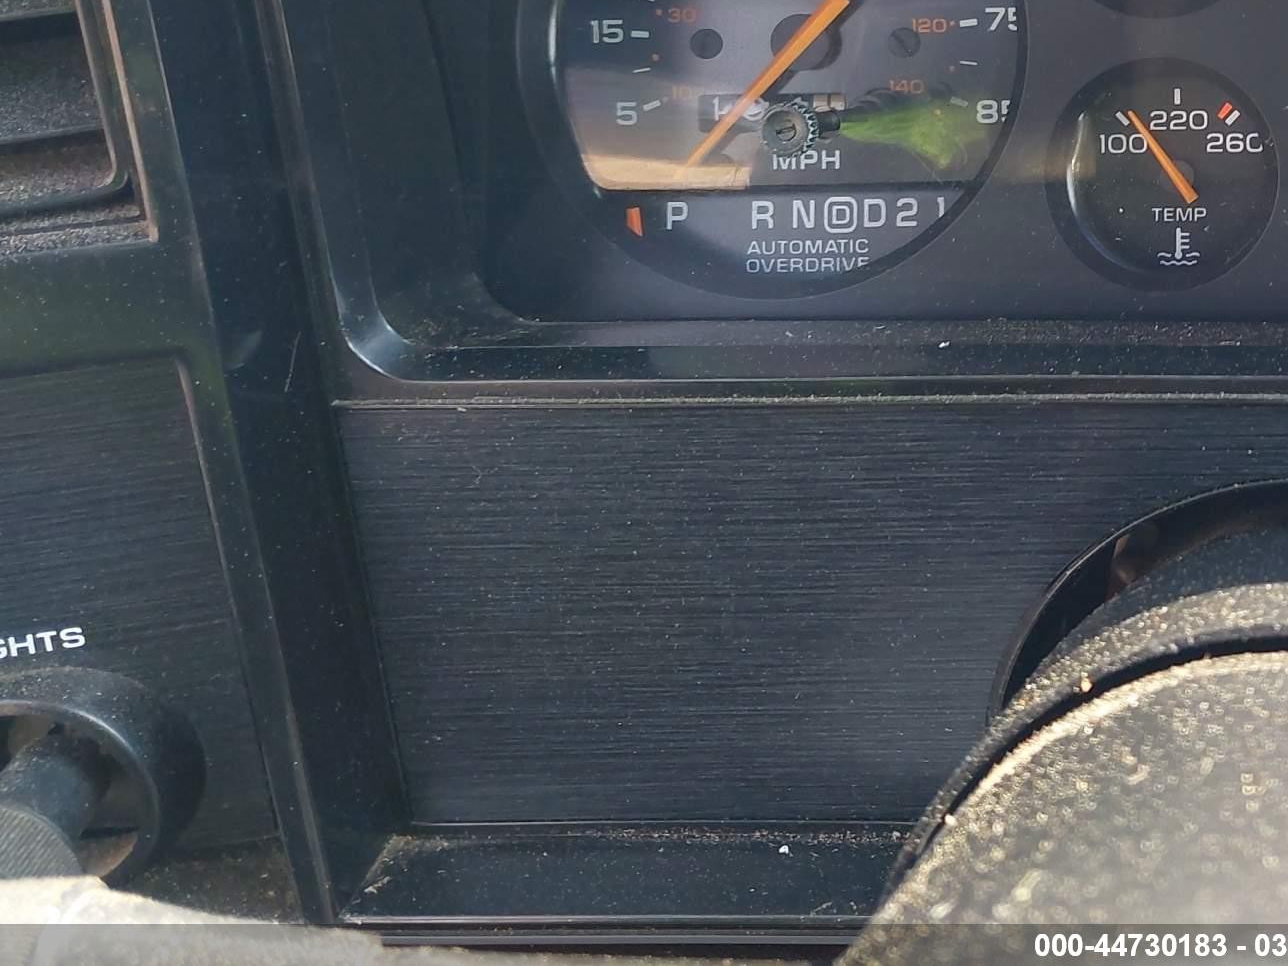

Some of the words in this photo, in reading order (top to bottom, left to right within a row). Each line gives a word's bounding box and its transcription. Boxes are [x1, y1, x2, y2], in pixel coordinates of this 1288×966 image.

[668, 8, 696, 23] 30
[912, 18, 947, 33] 120
[590, 20, 624, 43] 15
[889, 79, 925, 95] 140
[616, 102, 637, 125] 5
[1149, 111, 1208, 131] 220
[1099, 134, 1147, 154] 100
[1206, 133, 1263, 153] 260
[773, 149, 840, 169] MPH
[666, 201, 688, 230] P
[751, 200, 774, 229] R
[793, 200, 815, 229] N
[863, 198, 886, 228] D
[896, 198, 918, 227] 2
[1152, 207, 1207, 223] TEMP
[747, 239, 869, 255] AUTOMATIC
[746, 257, 870, 274] OVERDRIVE
